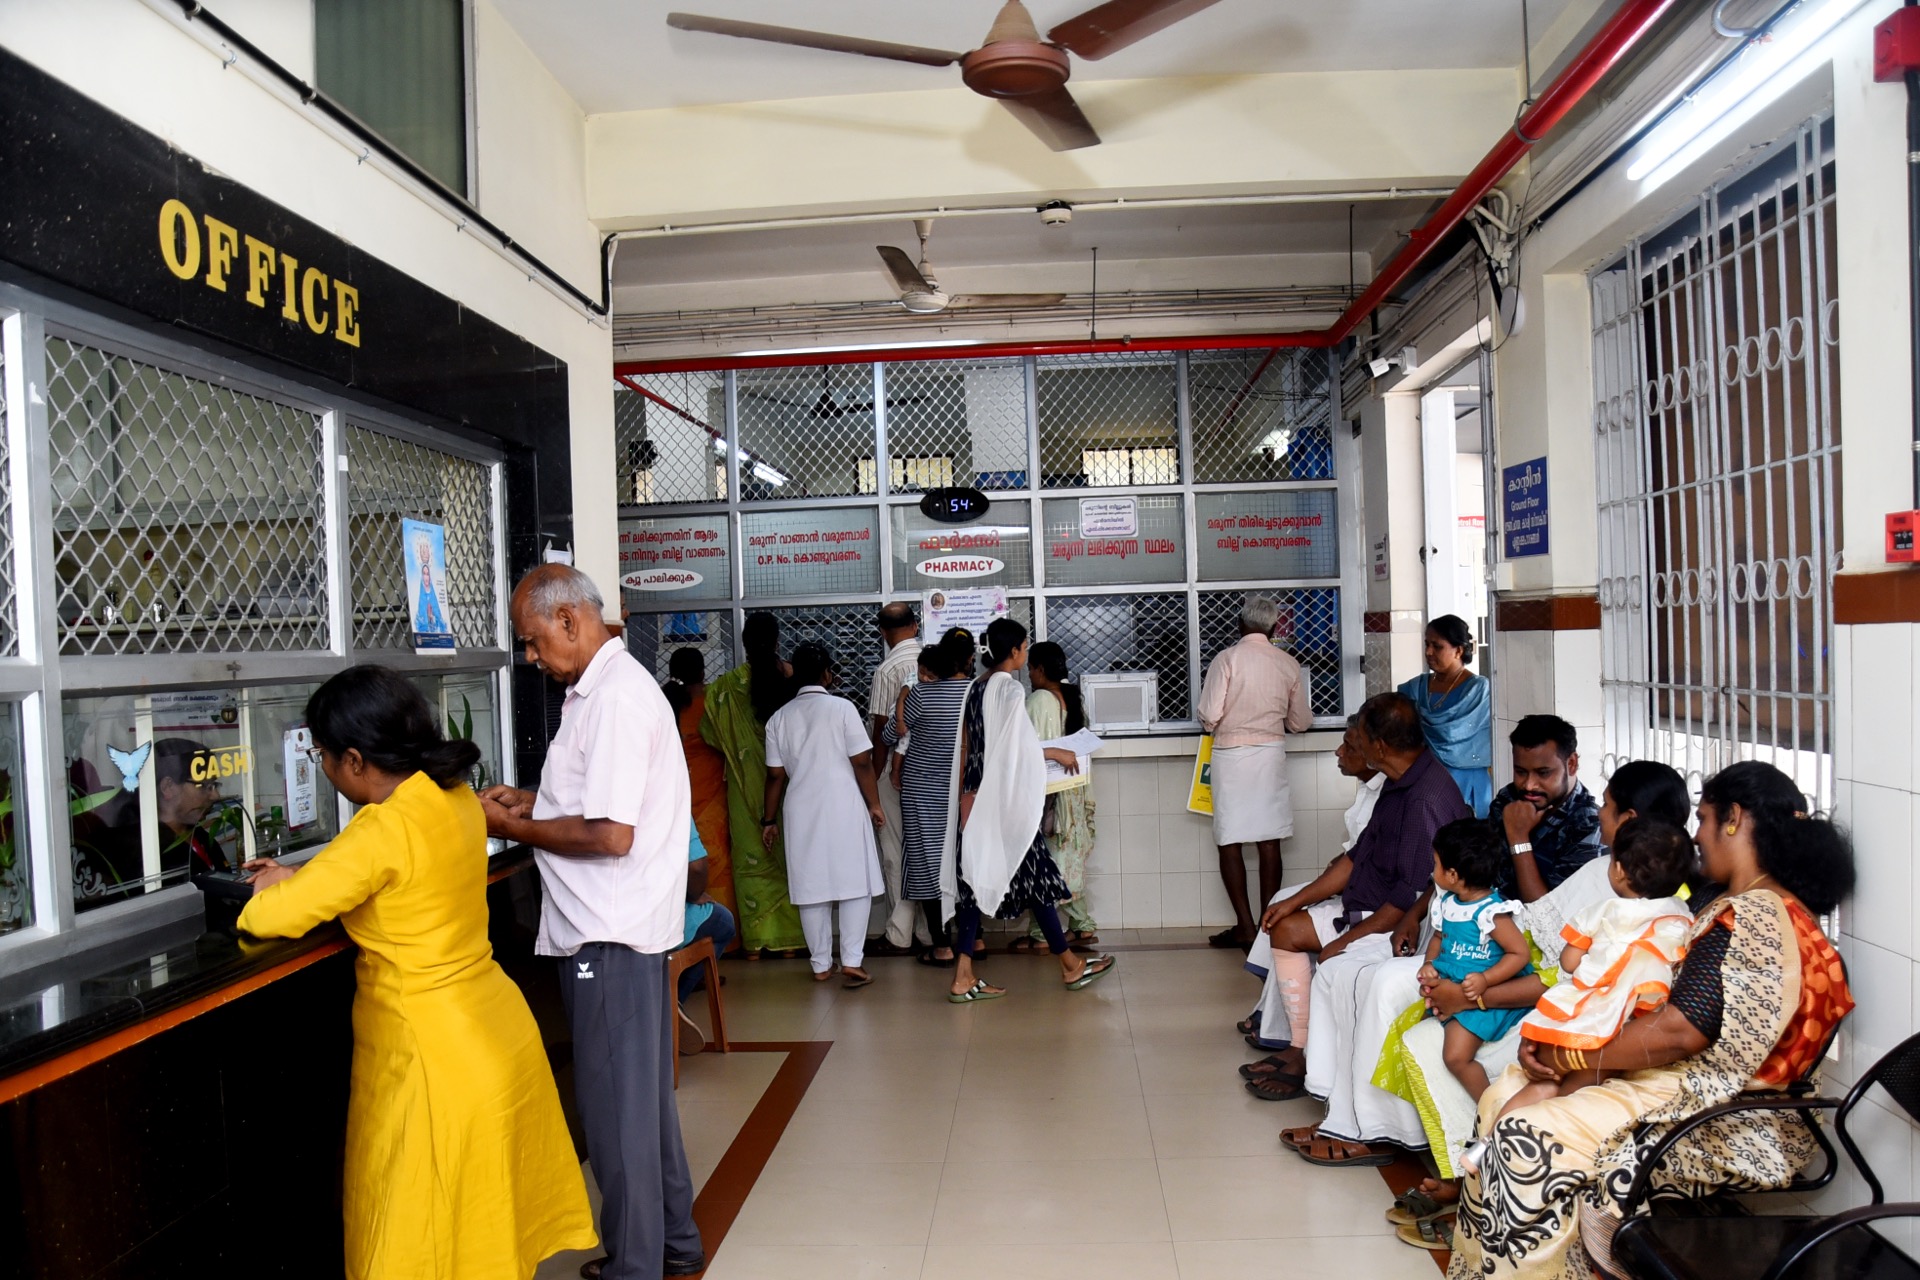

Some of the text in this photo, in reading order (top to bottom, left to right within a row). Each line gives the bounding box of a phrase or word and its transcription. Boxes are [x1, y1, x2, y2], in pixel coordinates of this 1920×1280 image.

[159, 199, 360, 347] OFFICE
[951, 499, 969, 512] 54
[1511, 497, 1540, 512] Ground Floor
[1207, 515, 1237, 531] മരുന്ന്
[632, 528, 692, 545] ലഭിക്കുന്നതിന്
[694, 529, 718, 542] ആദ്യം
[749, 527, 870, 548] മരുന്ന് വാങ്ങാൻ വരുമ്പോൾ
[919, 529, 1000, 550] ഫാർമസി
[1242, 536, 1312, 550] കൊണ്ടുവരണം
[686, 547, 726, 558] വാങ്ങണം
[757, 551, 861, 565] O.P. No. കൊണ്ടുവരണം
[1052, 539, 1085, 562] മരുന്ന്
[1087, 539, 1138, 560] ലഭിക്കുന്ന
[924, 559, 994, 573] PHARMACY
[643, 572, 695, 584] പാലിക്കുക
[190, 752, 249, 782] CASH
